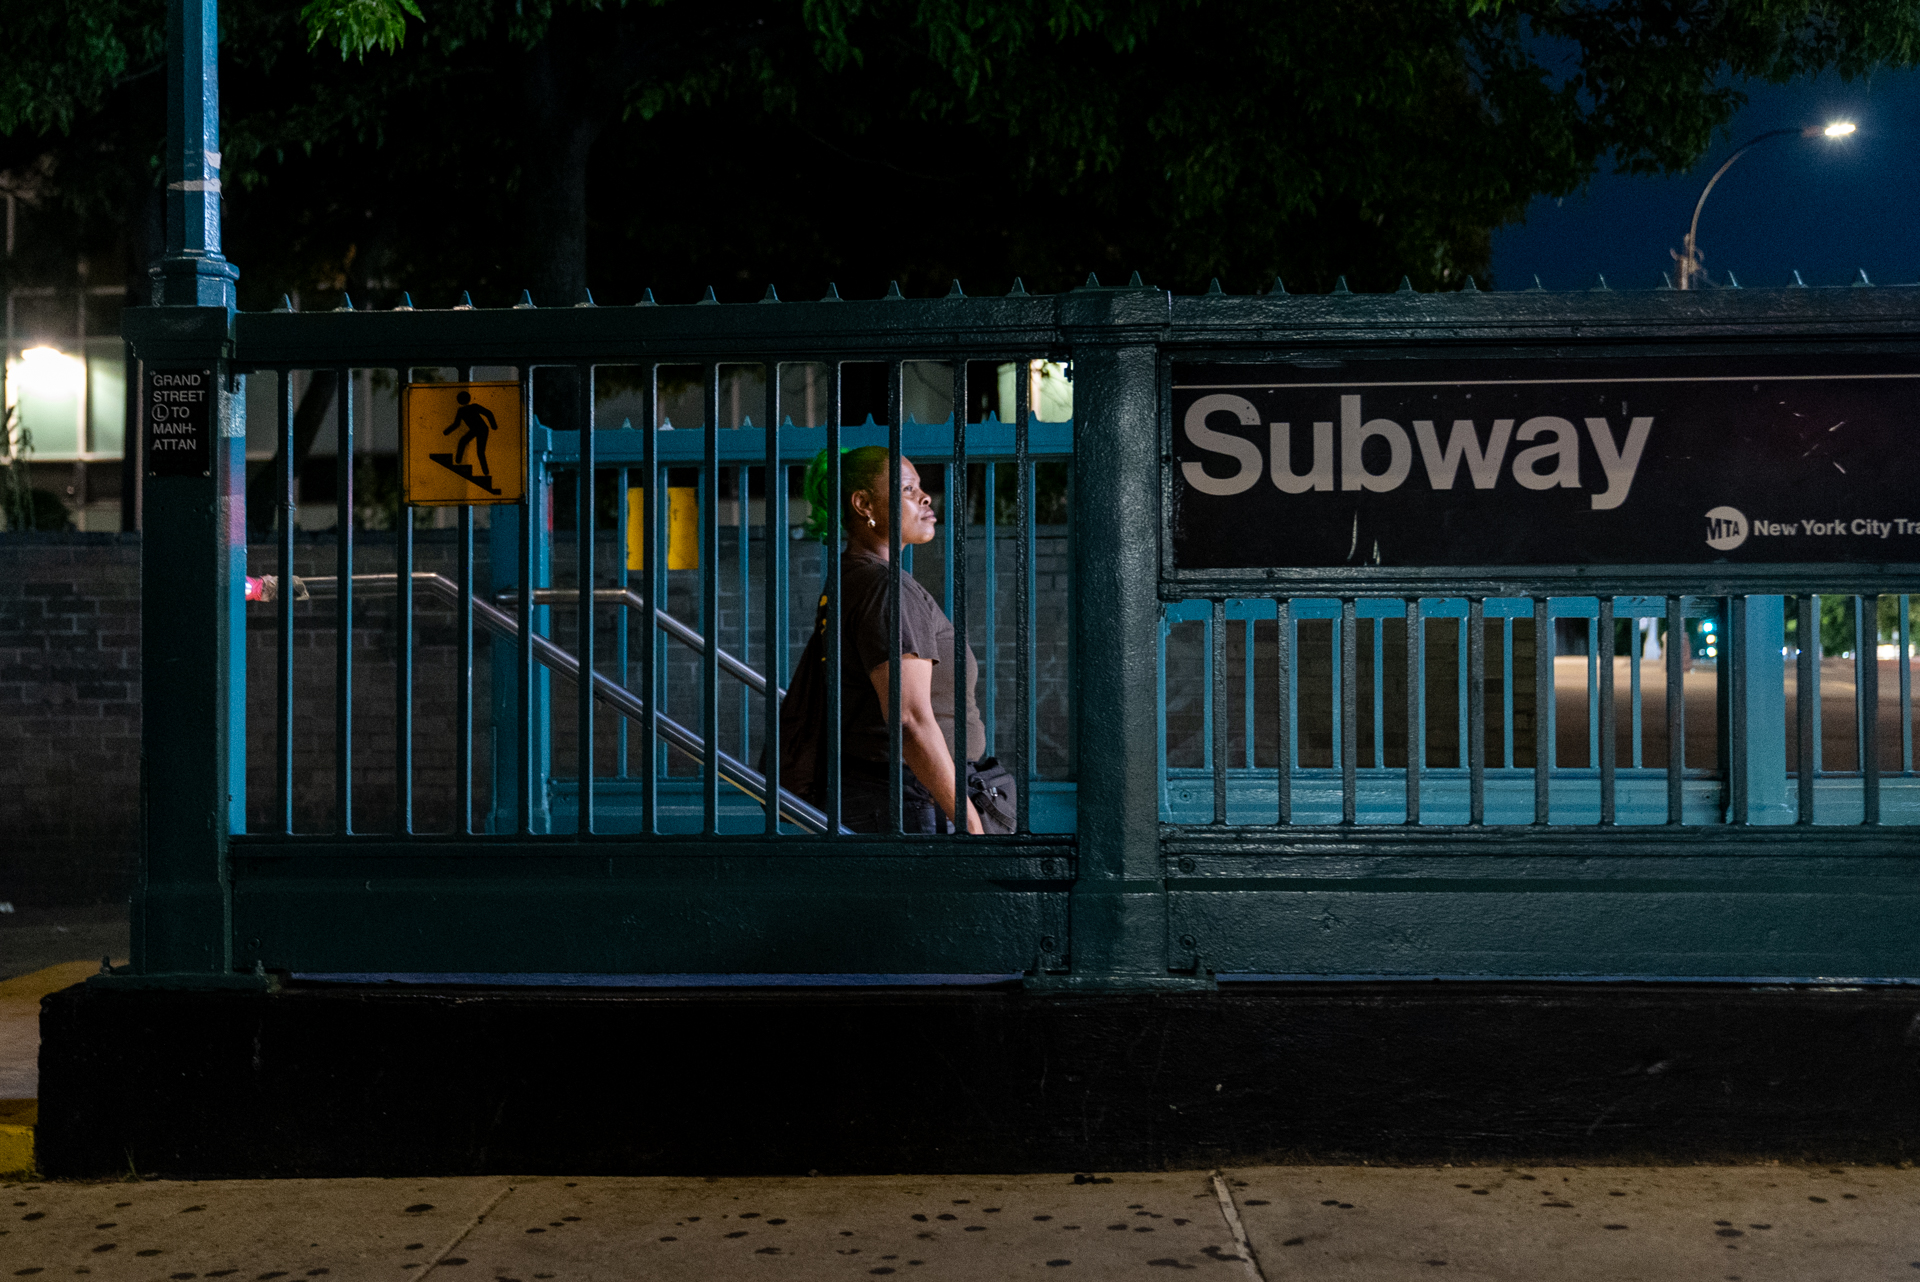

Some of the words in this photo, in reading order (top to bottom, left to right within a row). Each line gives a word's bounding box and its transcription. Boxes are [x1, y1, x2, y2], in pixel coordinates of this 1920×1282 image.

[153, 374, 202, 387] GRAND
[152, 390, 206, 403] STREET
[170, 406, 190, 419] TO
[152, 422, 197, 435] MANH-
[151, 438, 197, 451] ATTAN
[1181, 392, 1655, 510] Subway
[1705, 515, 1742, 543] MTA
[1753, 519, 1799, 536] New
[1800, 518, 1847, 536] York
[1850, 518, 1892, 539] City
